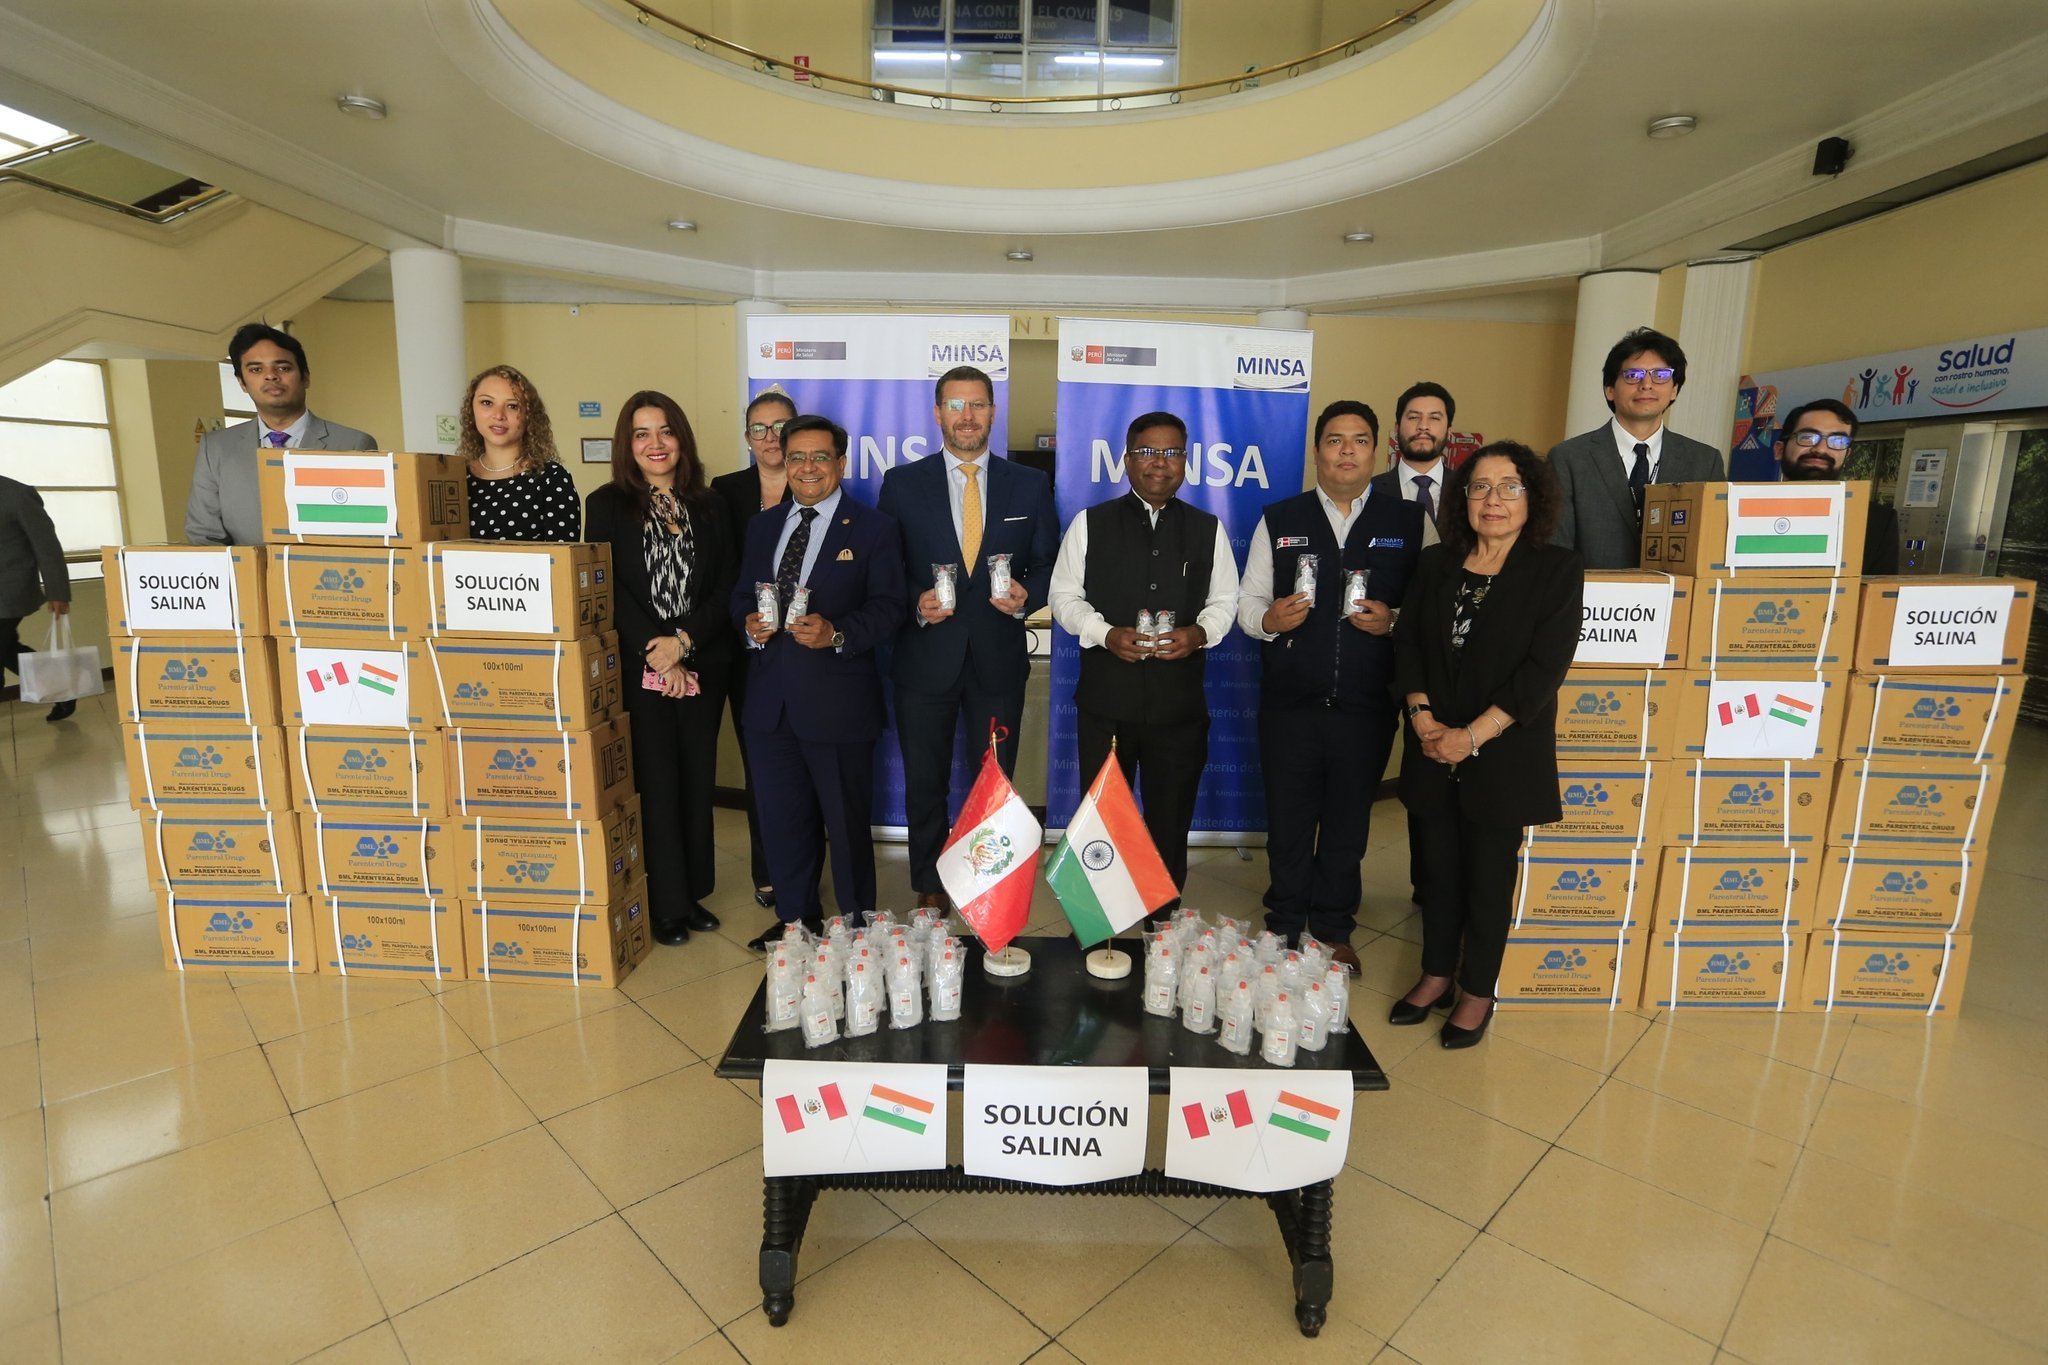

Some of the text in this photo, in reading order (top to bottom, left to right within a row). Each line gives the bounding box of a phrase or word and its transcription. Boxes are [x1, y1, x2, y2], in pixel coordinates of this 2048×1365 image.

[931, 344, 1004, 363] MINSA
[1237, 356, 1306, 377] MINSA
[1949, 372, 1973, 380] rostro
[1975, 367, 2009, 378] humano,
[1932, 383, 1957, 394] social
[1967, 379, 2006, 393] inclusivo
[843, 435, 943, 480] INS
[1091, 439, 1269, 489] MNSA
[1675, 511, 1684, 520] NS
[139, 572, 219, 589] SOLUCIÓN
[455, 573, 540, 592] SOLUCIÓN
[151, 596, 206, 610] SALINA
[467, 596, 527, 612] SALINA
[1582, 604, 1656, 622] OLUCIÓN
[1906, 607, 1997, 625] SOLUCIÓN
[1578, 628, 1638, 642] SALINA
[1783, 627, 1805, 635] Drugs
[1914, 631, 1976, 645] SALINA
[1205, 651, 1242, 662] isterio
[483, 661, 523, 671] 100x100ml
[1605, 718, 1626, 726] Drugs
[374, 774, 394, 782] Drugs
[524, 774, 545, 782] Drugs
[1594, 809, 1614, 817] Drugs
[1586, 894, 1607, 902] Drugs
[368, 916, 405, 925] 100x100ml
[518, 923, 557, 933] 100x100ml
[983, 1100, 1129, 1129] SOLUCIÓN
[1000, 1134, 1103, 1159] SALINA
